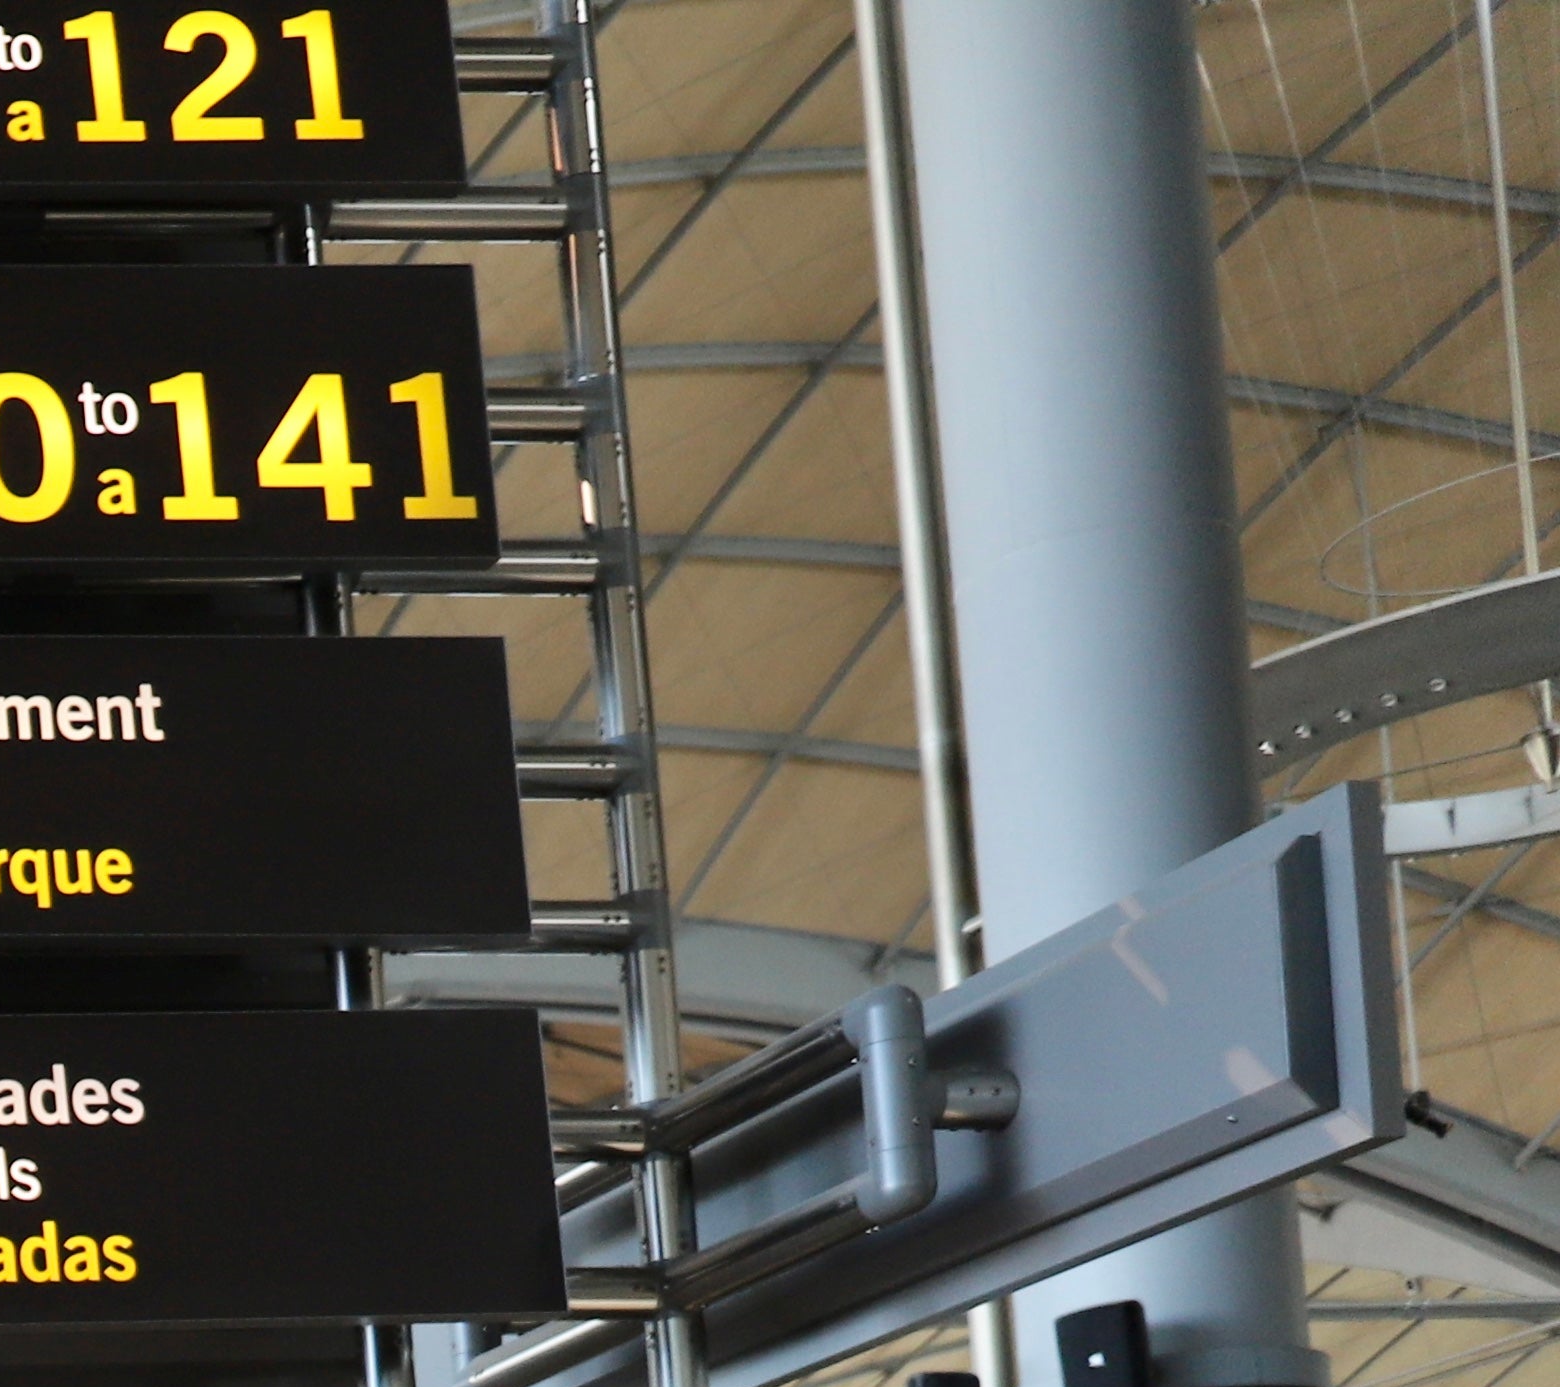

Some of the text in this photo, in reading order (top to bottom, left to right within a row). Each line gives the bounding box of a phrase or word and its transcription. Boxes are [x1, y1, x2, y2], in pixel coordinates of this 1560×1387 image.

[6, 99, 45, 142] a
[63, 9, 365, 142] 121
[77, 381, 139, 435] to
[149, 371, 478, 522] 141
[97, 467, 136, 515] a
